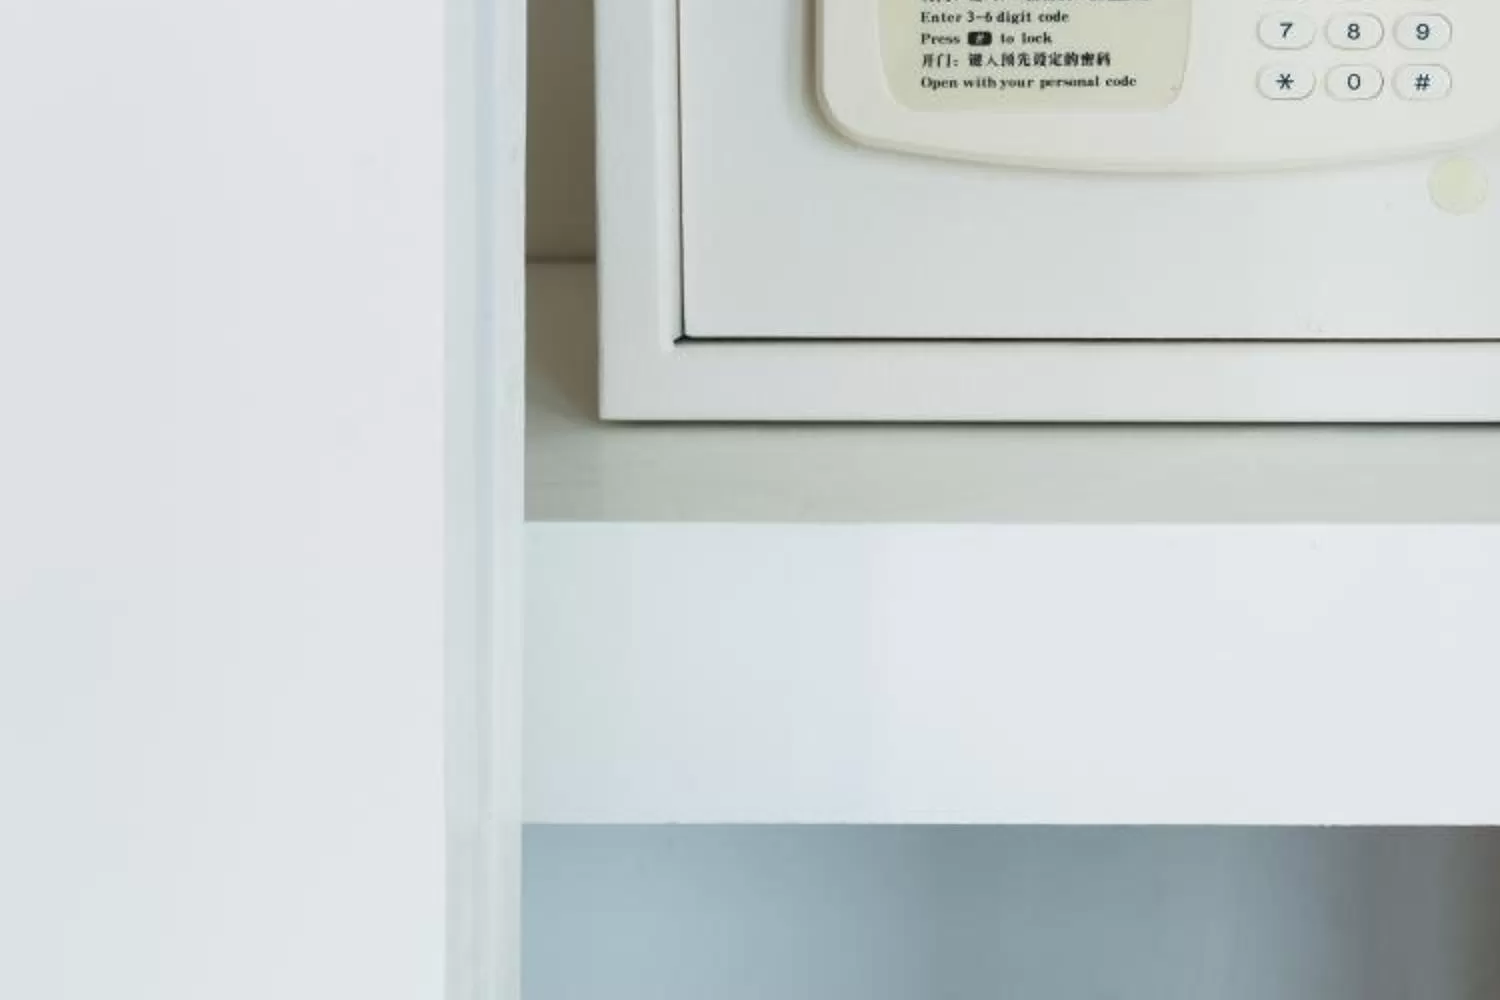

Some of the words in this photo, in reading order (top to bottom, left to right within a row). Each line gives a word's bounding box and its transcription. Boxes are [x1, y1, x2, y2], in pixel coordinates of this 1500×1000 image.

[920, 11, 963, 23] Enter
[995, 10, 1032, 26] digit
[1037, 10, 1069, 22] code
[920, 33, 961, 45] Press
[999, 33, 1015, 44] to
[1021, 32, 1053, 44] lock
[1279, 22, 1294, 38] 7
[1346, 23, 1361, 40] 8
[1415, 24, 1431, 40] 9
[920, 77, 959, 91] Open
[962, 76, 998, 88] with
[999, 79, 1036, 92] your
[1039, 75, 1100, 91] personal
[1105, 75, 1137, 88] code
[1346, 74, 1361, 90] 0
